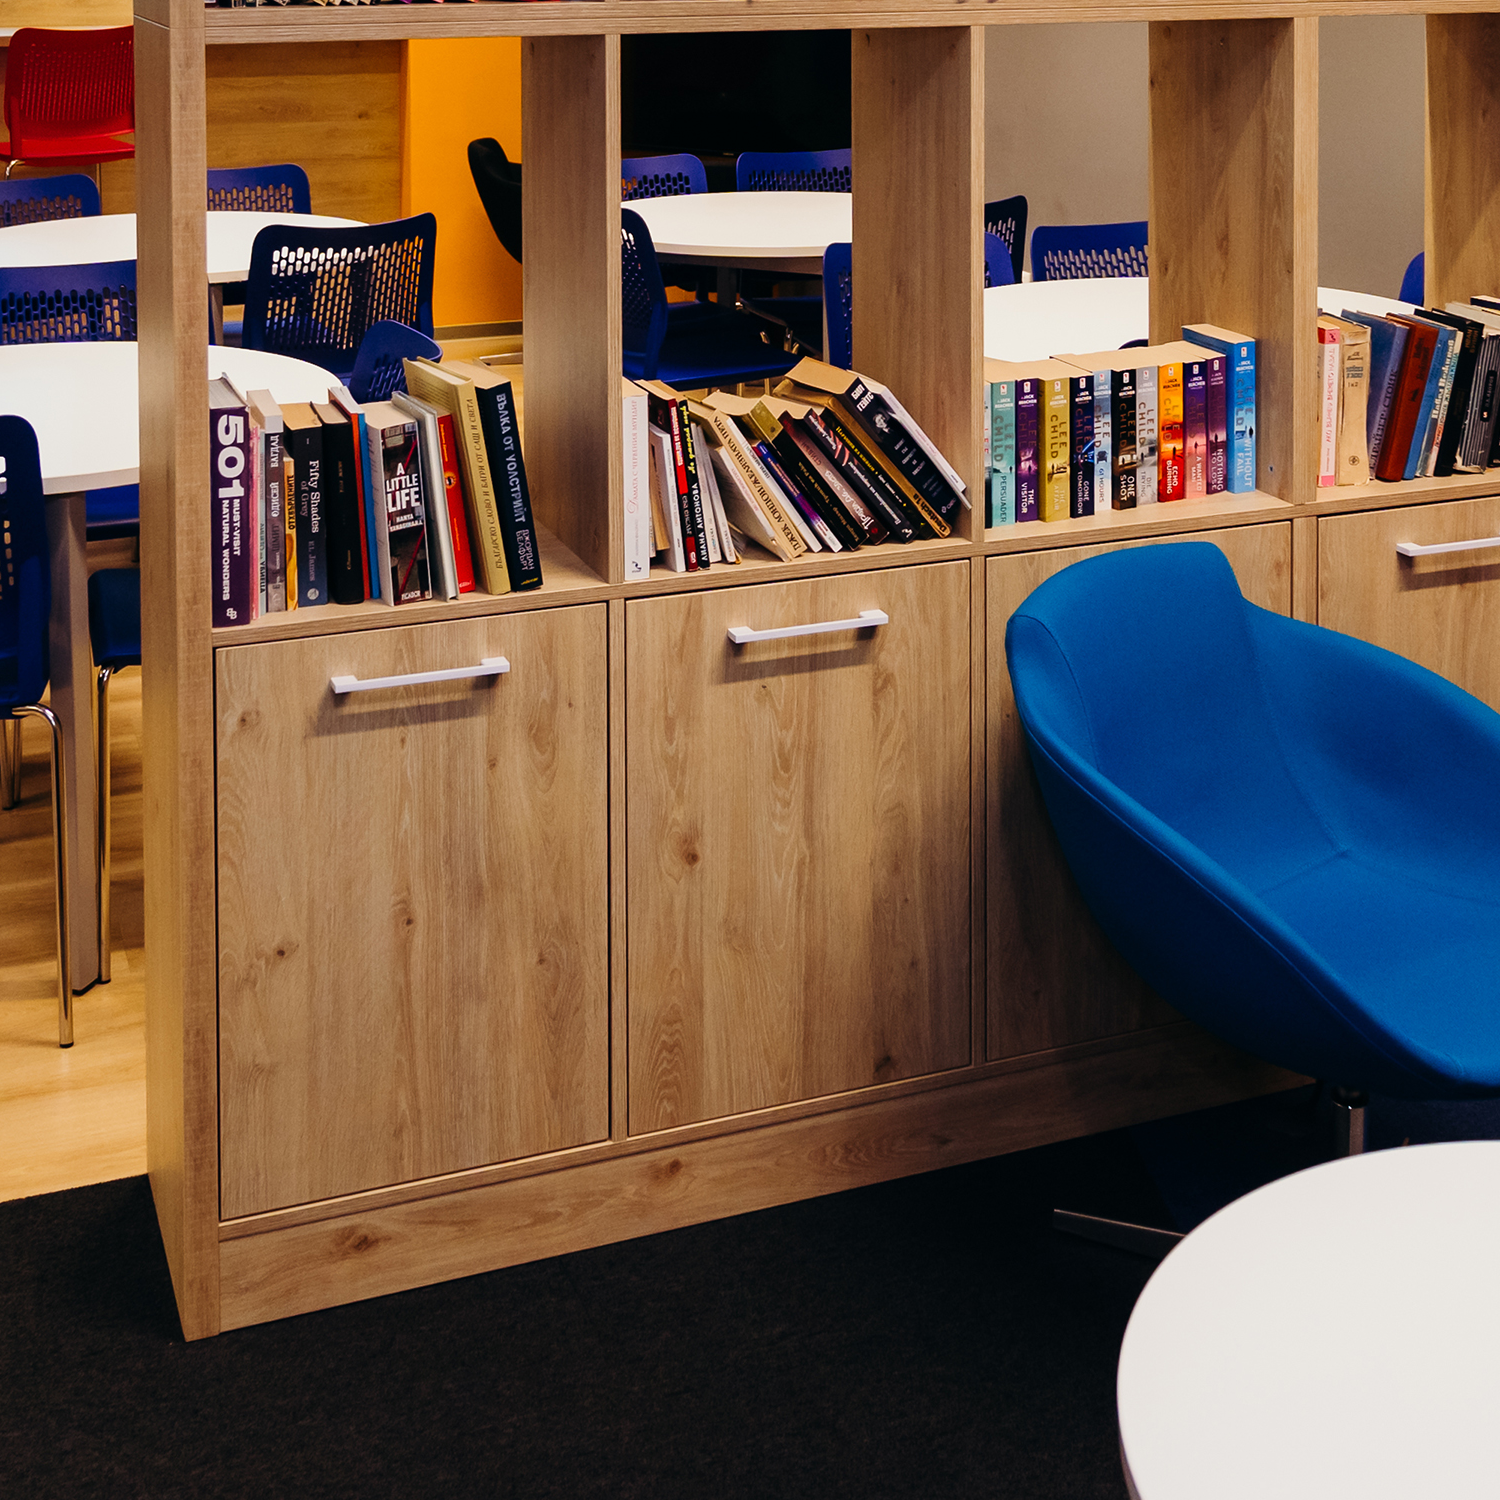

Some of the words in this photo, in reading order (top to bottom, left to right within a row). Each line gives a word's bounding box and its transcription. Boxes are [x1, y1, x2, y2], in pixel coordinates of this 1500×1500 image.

[1433, 338, 1459, 388] Вежинов
[851, 383, 865, 400] БИЛ
[856, 390, 875, 412] ГЕЙТС
[1235, 377, 1244, 426] CHILD
[1244, 386, 1253, 415] LEE
[1428, 386, 1447, 420] Павел
[465, 397, 477, 423] СВЕТА
[494, 392, 512, 434] ВЪЛКА
[629, 399, 638, 431] МУНДИР
[1119, 403, 1127, 447] CHILD
[1127, 409, 1136, 438] LEE
[1138, 401, 1146, 446] CHILD
[1146, 409, 1154, 435] LEE
[1163, 397, 1172, 442] CHILD
[1172, 404, 1180, 431] LEE
[710, 414, 731, 440] ПЕТА
[993, 414, 1003, 463] CHILD
[1004, 422, 1013, 452] LEE
[1050, 414, 1059, 459] CHILD
[1058, 421, 1067, 450] LEE
[1075, 408, 1083, 453] CHILD
[1083, 415, 1092, 443] LEE
[1094, 404, 1102, 448] CHILD
[1101, 412, 1110, 439] LEE
[471, 431, 482, 451] САЩ
[501, 434, 514, 452] ОТ
[630, 431, 639, 469] ЧЕРВЕНИЯ
[217, 414, 245, 499] 501
[396, 462, 405, 476] A
[475, 451, 484, 464] ОТ
[1212, 452, 1217, 464] TO
[1244, 439, 1253, 487] WITHOUT
[299, 480, 308, 490] of
[307, 459, 320, 488] Fifty
[385, 473, 418, 493] LITTLE
[477, 464, 489, 489] БАГРИ
[503, 453, 528, 524] УОЛСТРИЙТ
[724, 435, 786, 526] ЛОНДОН/ЖЕЛЯЗНАТА
[1119, 474, 1128, 501] SHOT
[1126, 476, 1135, 497] ONE
[286, 474, 295, 530] ОТХВЪРЛЕНИТЕ
[298, 492, 309, 517] Grey
[308, 491, 322, 533] Shades
[386, 487, 420, 513] LIFE
[483, 497, 495, 525] СЛОВО
[690, 482, 704, 529] АНТОНОВА
[910, 492, 923, 504] 1a
[222, 499, 230, 546] NATURAL
[233, 499, 241, 556] MUST-VISIT
[917, 500, 948, 534] Deutsch
[488, 525, 503, 570] БЪЛГАРСКО
[512, 529, 530, 572] БЕЛФЪРТ
[519, 527, 537, 571] ДЖОРДАН
[696, 531, 708, 561] ЛИАНА
[778, 521, 802, 552] ДЖЕК
[222, 548, 231, 601] WONDERS
[401, 590, 421, 600] PICADOR
